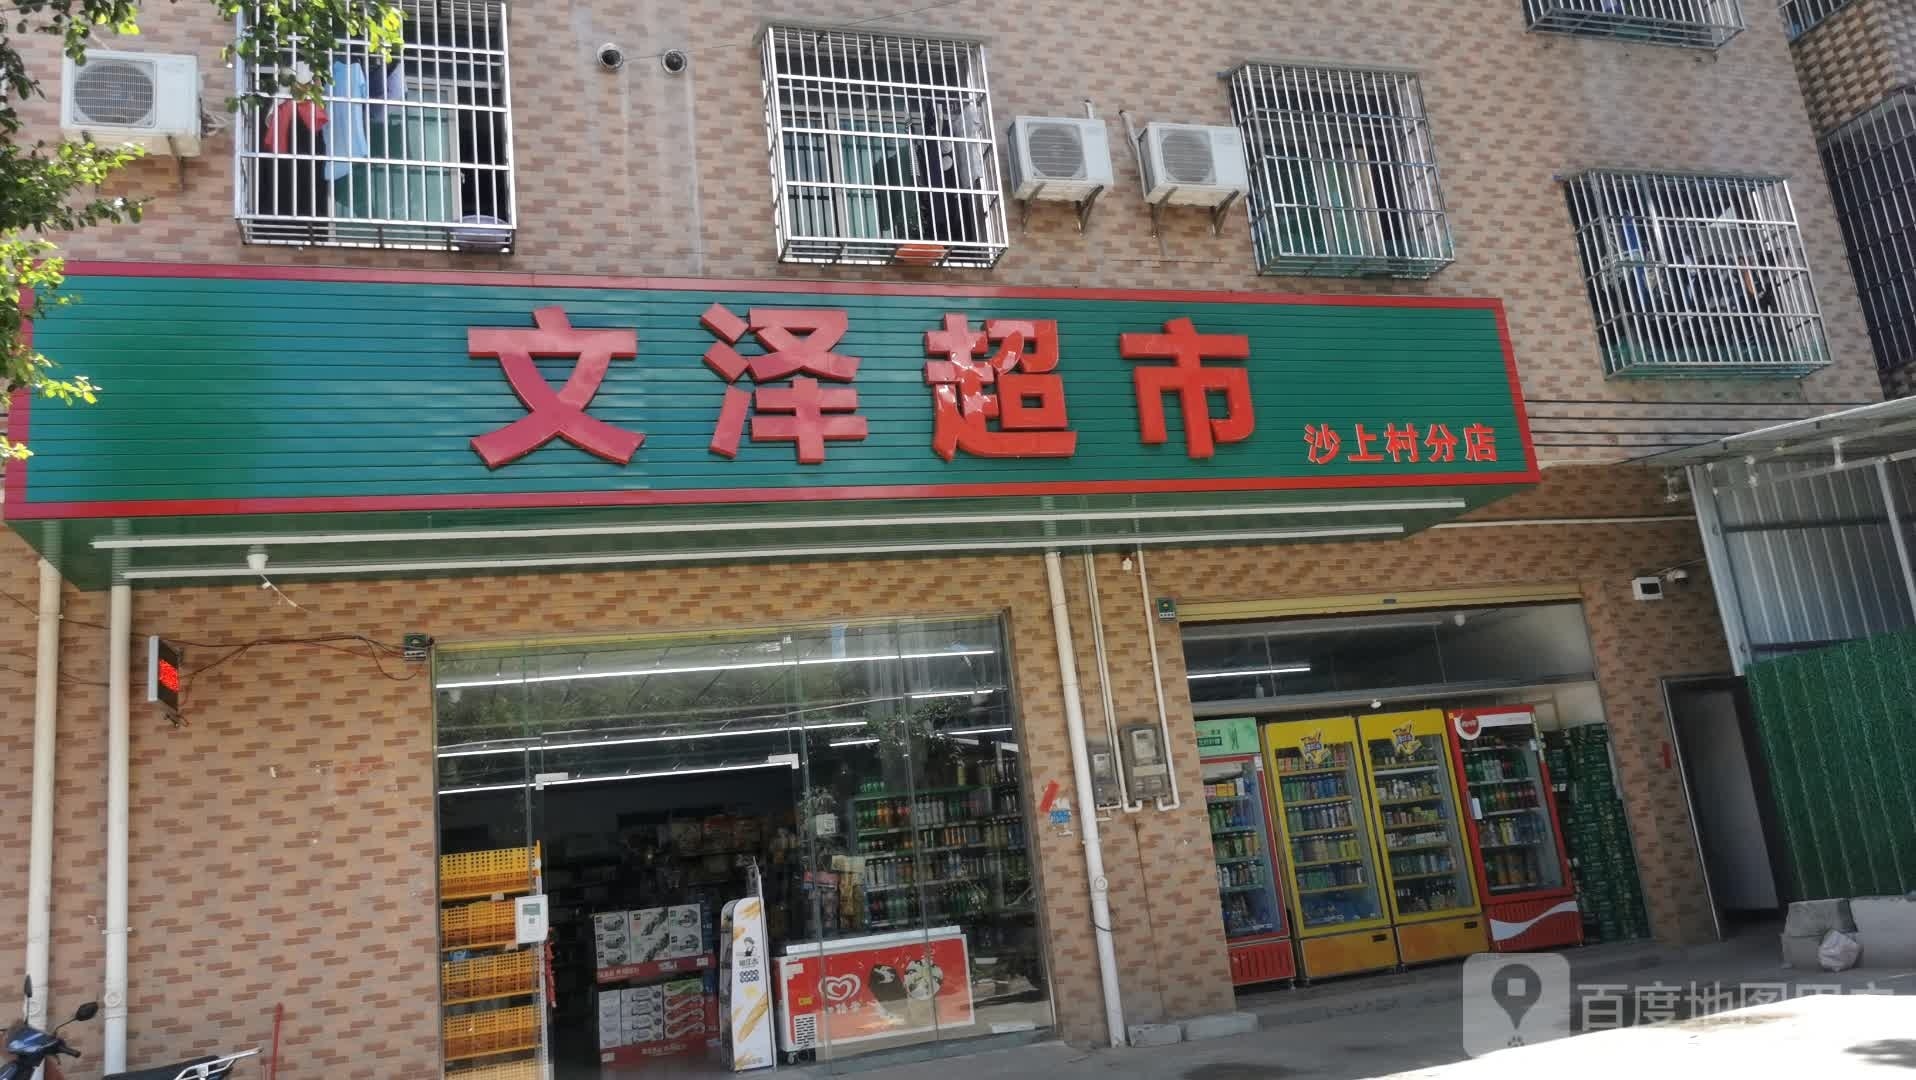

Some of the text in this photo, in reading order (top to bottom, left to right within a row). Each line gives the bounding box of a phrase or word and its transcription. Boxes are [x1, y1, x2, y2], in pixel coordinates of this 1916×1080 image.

[467, 303, 1256, 471] 文泽超市
[1304, 423, 1497, 464] 沙上村分店
